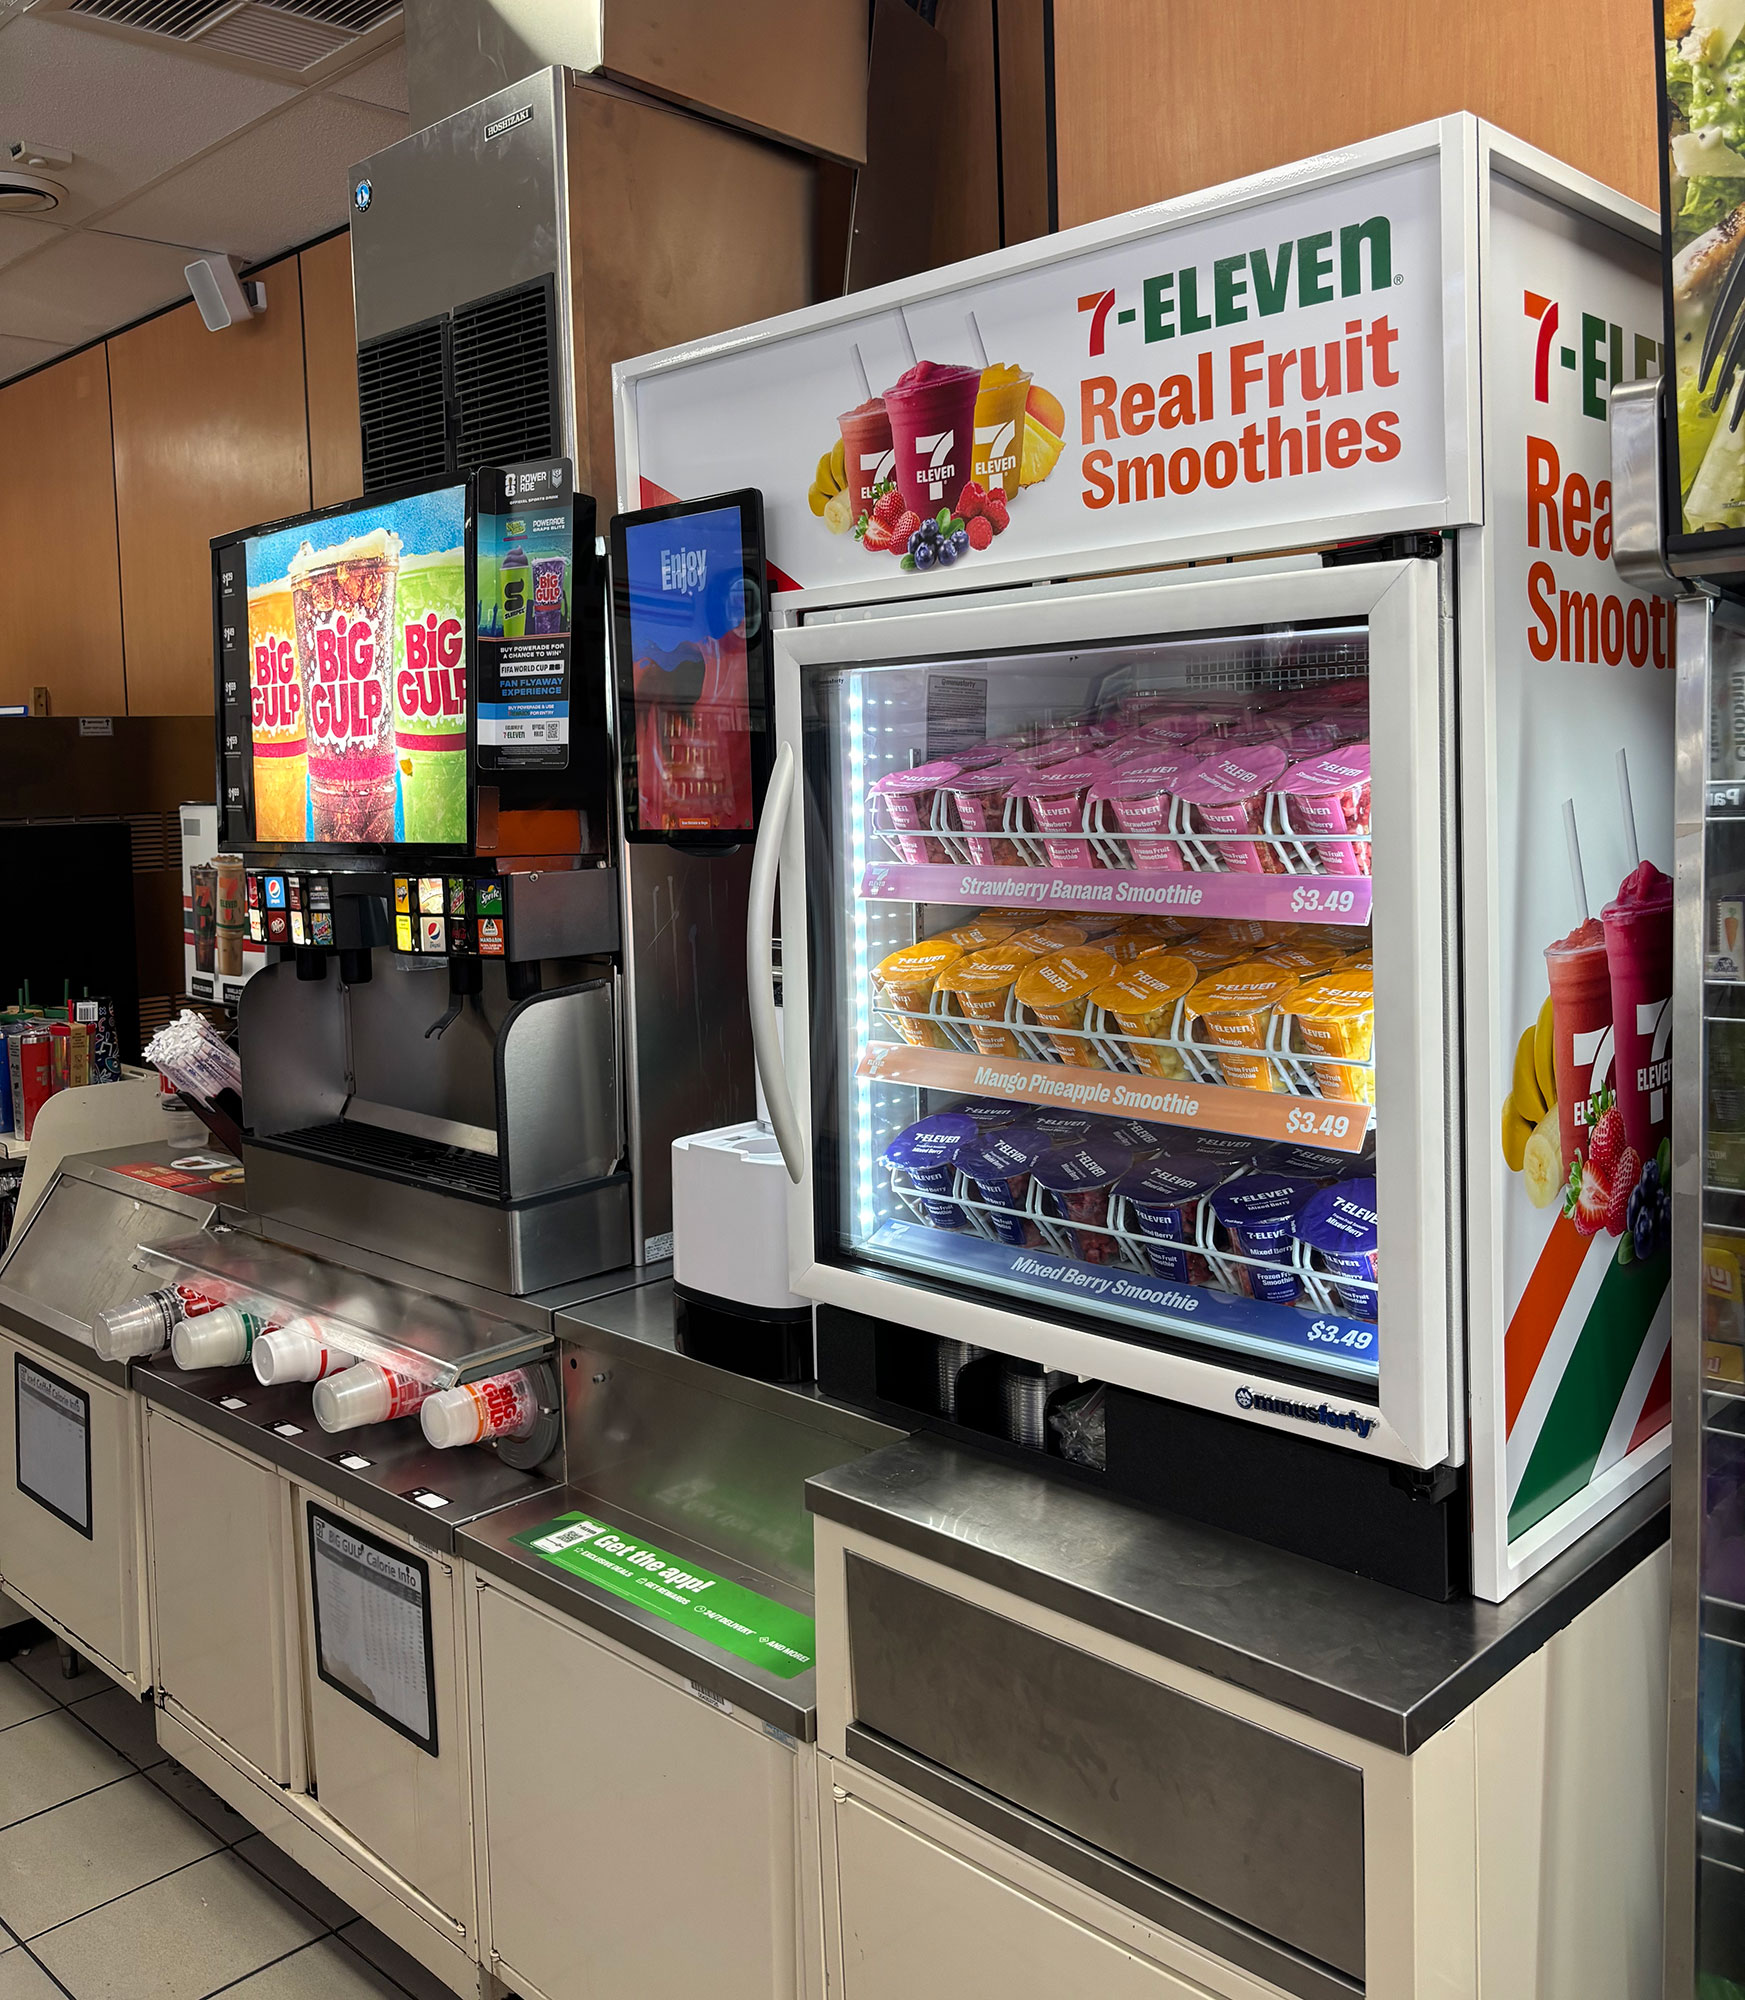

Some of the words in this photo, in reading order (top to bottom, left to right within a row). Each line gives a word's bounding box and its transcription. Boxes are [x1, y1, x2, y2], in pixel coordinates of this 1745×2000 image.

[487, 108, 529, 136] HOSHIZAKI
[1080, 352, 1214, 446] Real
[1229, 313, 1400, 409] Fruit
[1081, 409, 1402, 511] Smoothies
[519, 471, 547, 483] POWER
[519, 482, 535, 493] ADE
[1526, 435, 1613, 561] Rea
[533, 517, 565, 527] POWERADE
[536, 587, 560, 603] GULP
[508, 651, 535, 659] CHANCE
[513, 644, 550, 652] POWERADE
[501, 666, 513, 674] FIFA
[514, 664, 536, 673] WORLD
[500, 680, 518, 688] FAN
[520, 677, 564, 687] FLYAWAY
[502, 687, 562, 697] EXPERIENCE
[251, 683, 300, 727] GULP
[311, 680, 382, 739] GULP
[1153, 846, 1171, 854] Fruit
[960, 876, 1048, 901] Strawberry
[1050, 879, 1112, 901] Banana
[1116, 881, 1203, 905] Smoothie
[1290, 885, 1355, 913] $3.49
[1241, 1065, 1259, 1074] Fruit
[974, 1065, 1028, 1094] Mango
[1030, 1071, 1111, 1105] Pineapple
[1111, 1085, 1199, 1116] Smoothie
[1286, 1106, 1350, 1138] $3.49
[1246, 1202, 1268, 1211] Mixed
[1268, 1199, 1291, 1209] Berry
[1325, 1215, 1346, 1230] Mixed
[1341, 1223, 1364, 1239] Berry
[1161, 1254, 1178, 1263] Fruit
[1249, 1248, 1272, 1256] Mixed
[1272, 1245, 1293, 1255] Berry
[1256, 1272, 1280, 1281] Frozen
[1262, 1278, 1294, 1286] Smoothie
[1009, 1256, 1065, 1282] Mixed
[1063, 1267, 1109, 1294] Berry
[1111, 1279, 1199, 1312] Smoothie
[1306, 1319, 1374, 1350] $3.49
[482, 1383, 504, 1428] GULP
[1254, 1393, 1374, 1439] minusforty
[342, 1539, 364, 1559] GULP
[366, 1552, 396, 1578] Calorie
[397, 1566, 416, 1587] Info
[580, 1550, 613, 1570] EXCLUSIVE
[608, 1562, 634, 1578] DEALS
[593, 1534, 637, 1557] Get
[626, 1550, 666, 1572] the
[658, 1567, 716, 1594] app!
[644, 1580, 662, 1592] GET
[657, 1586, 691, 1605] REWARDS
[766, 1641, 786, 1651] AND
[782, 1648, 810, 1663] MORE!
